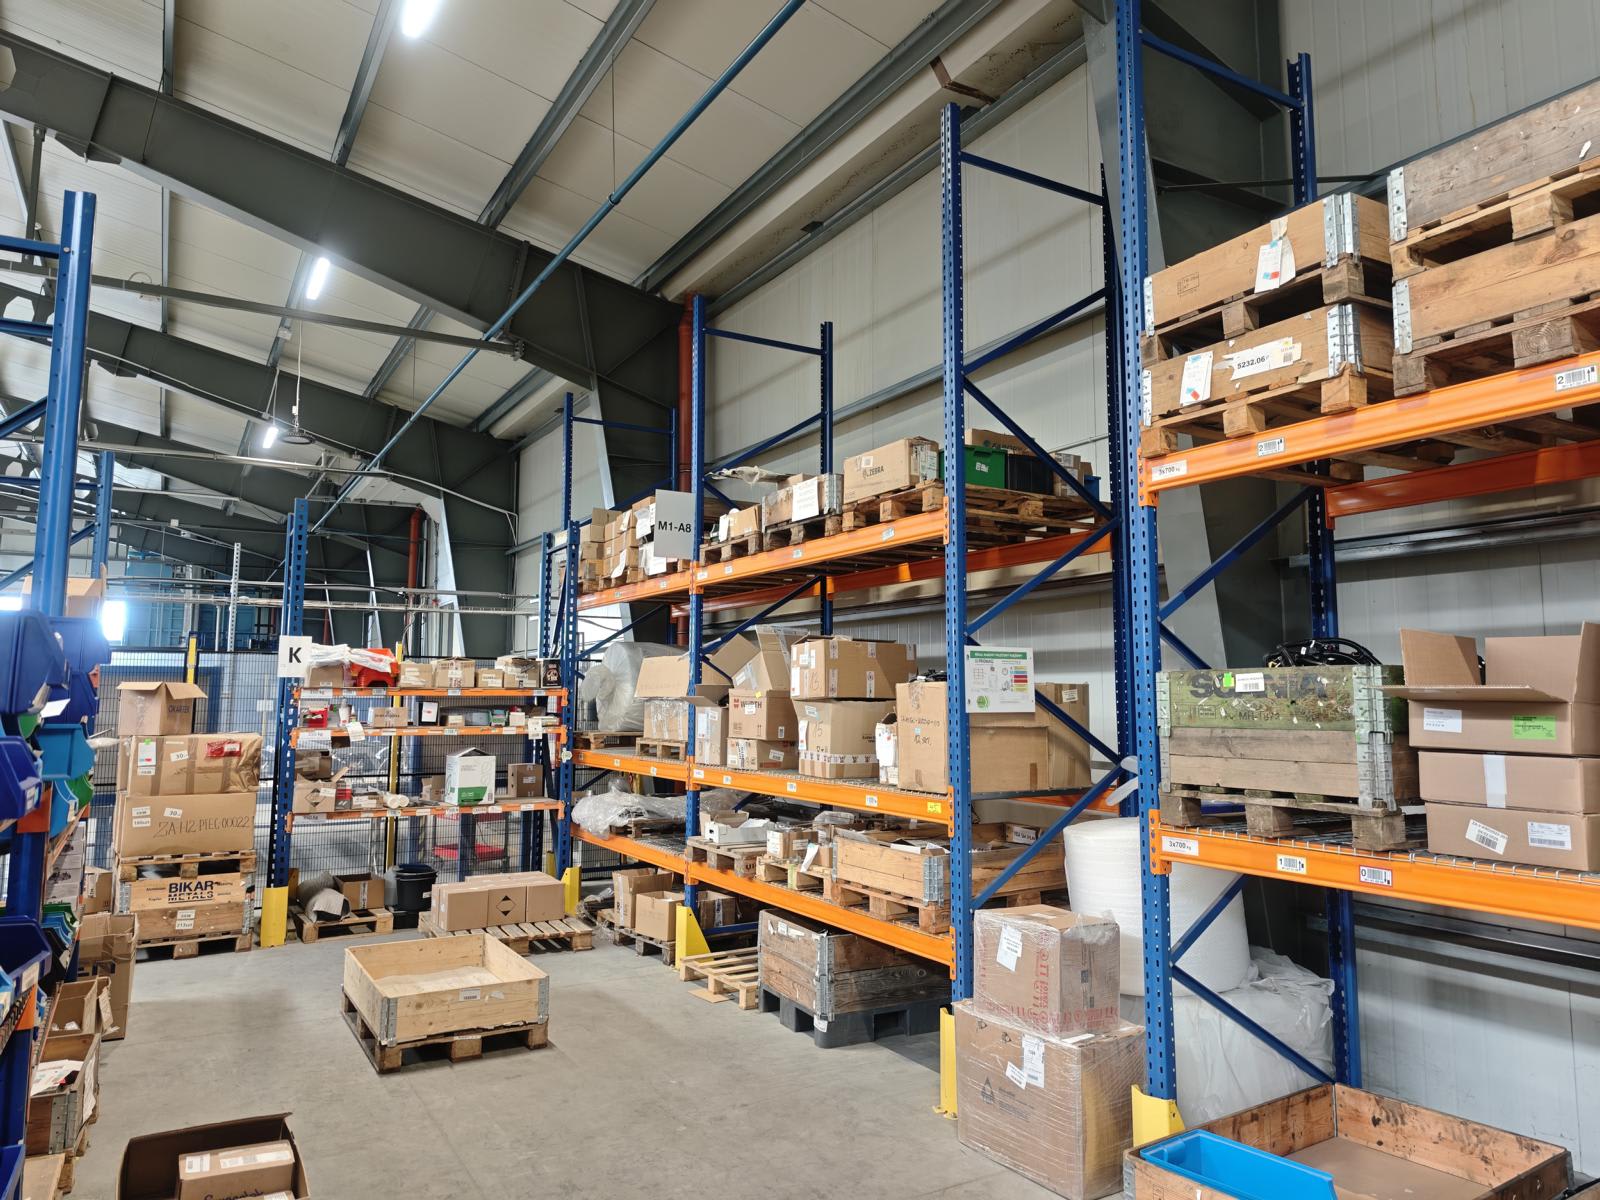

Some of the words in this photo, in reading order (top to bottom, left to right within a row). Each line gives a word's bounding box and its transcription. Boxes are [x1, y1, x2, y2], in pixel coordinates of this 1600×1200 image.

[1558, 376, 1564, 384] 2
[869, 465, 885, 477] ZEBRA
[658, 520, 692, 533] M1-A8
[288, 647, 302, 664] K
[1168, 840, 1186, 849] 3x700
[168, 880, 214, 894] BIKAR
